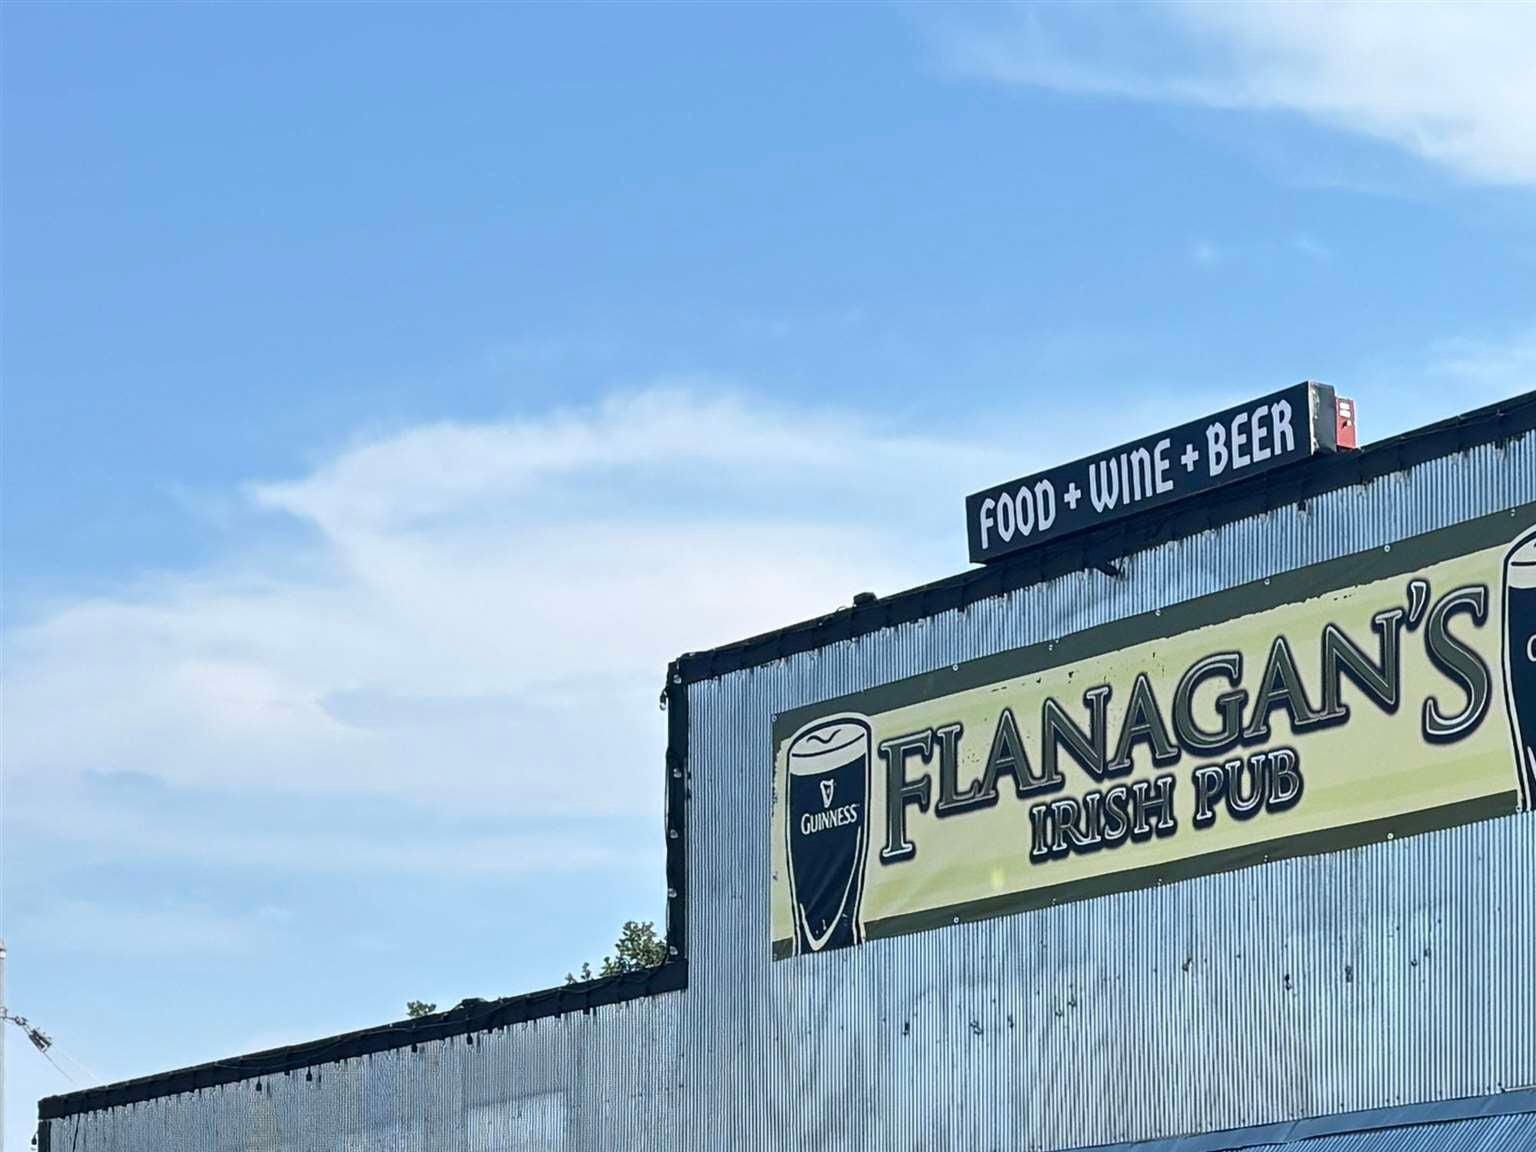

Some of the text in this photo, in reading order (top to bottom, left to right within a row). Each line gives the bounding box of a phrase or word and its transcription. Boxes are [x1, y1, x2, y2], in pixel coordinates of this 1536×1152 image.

[979, 479, 1056, 549] FOOD
[1088, 438, 1174, 513] WINE
[1205, 398, 1296, 477] BEER
[878, 577, 1492, 865] FLANAGAN'S
[801, 804, 858, 835] GUINNESS
[1030, 747, 1304, 864] IRISH PUB
